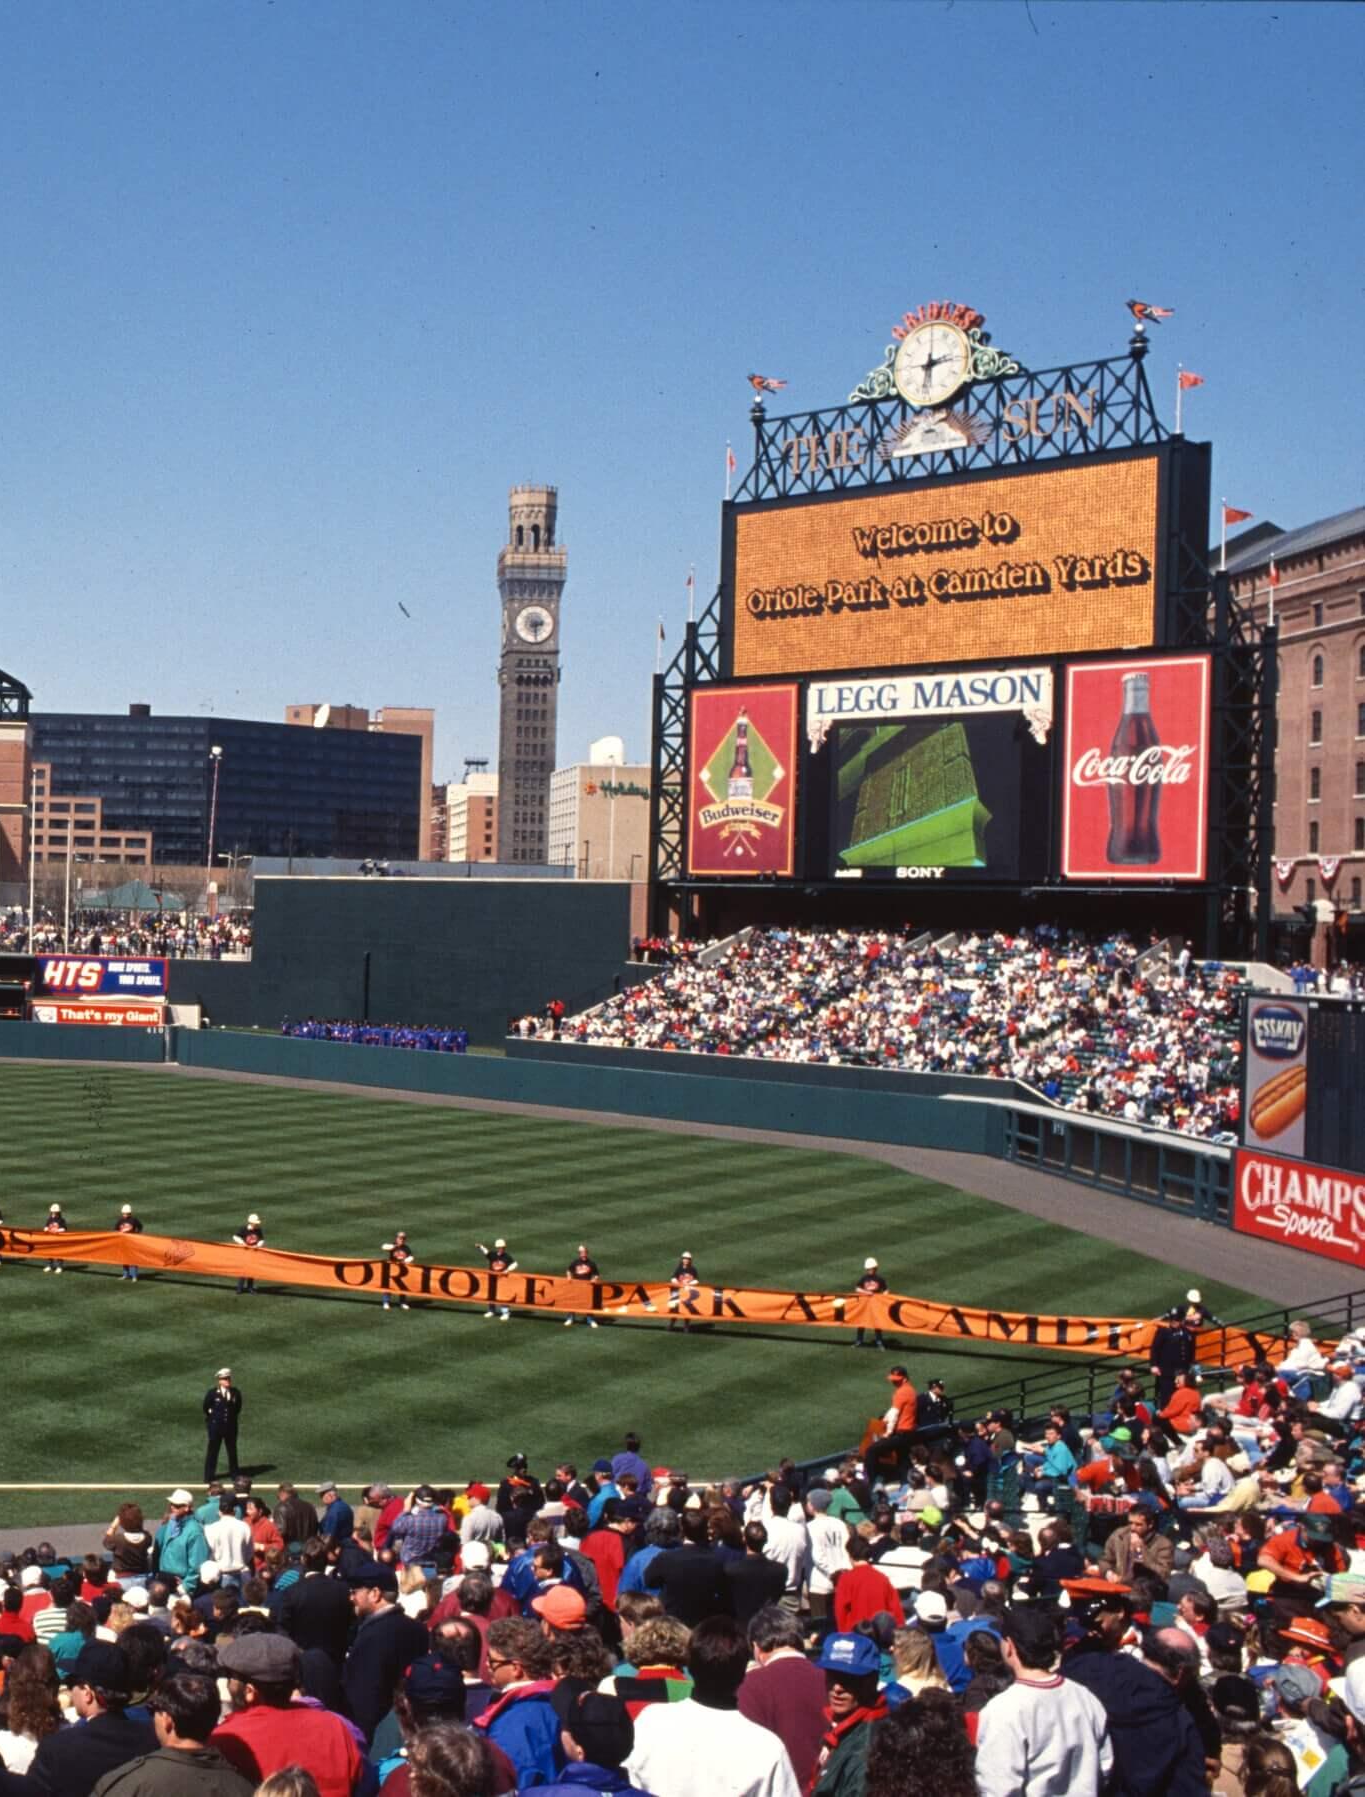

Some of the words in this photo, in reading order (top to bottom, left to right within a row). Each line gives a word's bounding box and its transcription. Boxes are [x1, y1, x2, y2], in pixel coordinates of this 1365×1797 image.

[782, 426, 868, 476] THE
[1002, 388, 1098, 442] SUN
[852, 517, 978, 555] Welcome
[981, 511, 1015, 542] to
[746, 588, 820, 615] Oriole
[825, 580, 885, 609] Park
[890, 575, 921, 601] at
[929, 560, 1043, 597] Camden
[1054, 549, 1146, 585] Yards
[815, 683, 899, 716] LEGG
[913, 674, 1045, 711] MASON
[1072, 744, 1198, 787] Coca-Cola
[701, 802, 780, 825] Budweiser
[895, 866, 946, 879] SONY
[44, 960, 103, 987] HTS
[60, 1008, 102, 1021] That's
[104, 1011, 124, 1024] my
[126, 1011, 159, 1022] Giant
[1241, 1160, 1365, 1240] CHAMPS
[1263, 1204, 1349, 1246] Sports
[334, 1261, 556, 1306] ORIOLE
[590, 1281, 747, 1318] PARK
[781, 1292, 860, 1323] AT
[887, 1299, 1140, 1351] CAMDE
